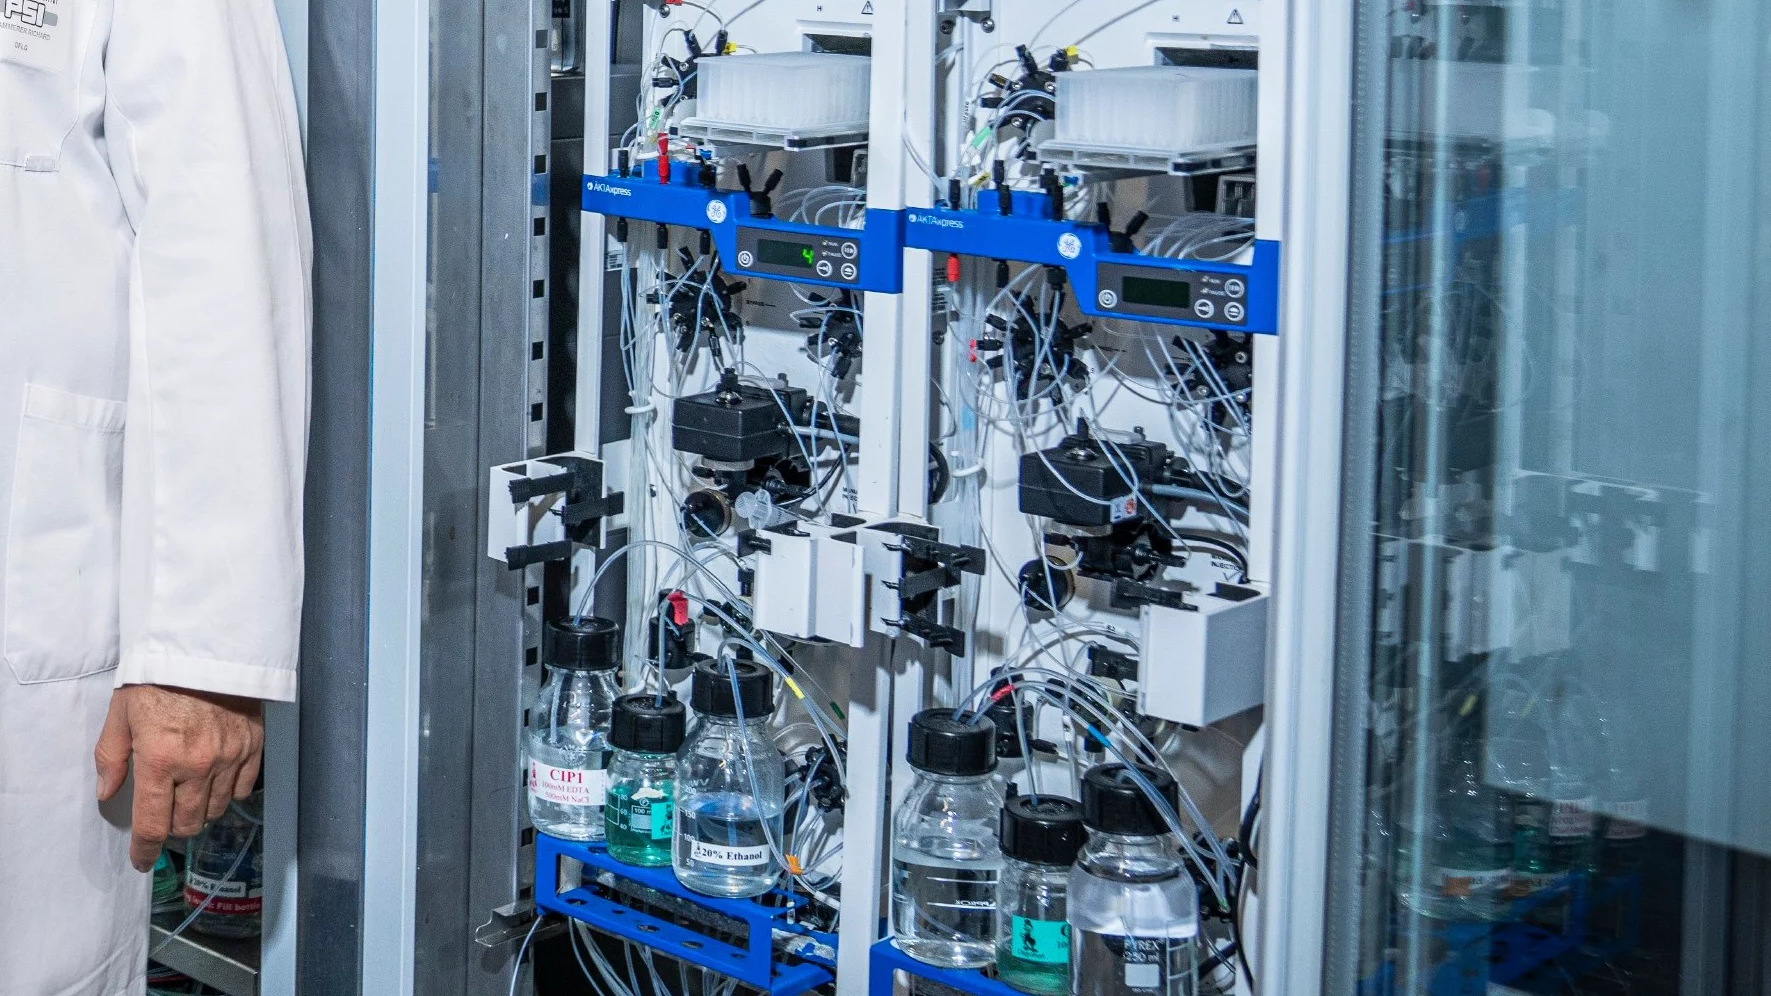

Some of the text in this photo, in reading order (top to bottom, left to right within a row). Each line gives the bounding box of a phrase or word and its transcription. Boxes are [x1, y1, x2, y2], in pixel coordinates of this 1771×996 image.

[801, 248, 815, 264] 4
[550, 768, 584, 784] CIP1
[541, 780, 590, 795] 100mM EDTA
[701, 847, 763, 861] 20% Ethanol
[1124, 938, 1161, 951] PREX
